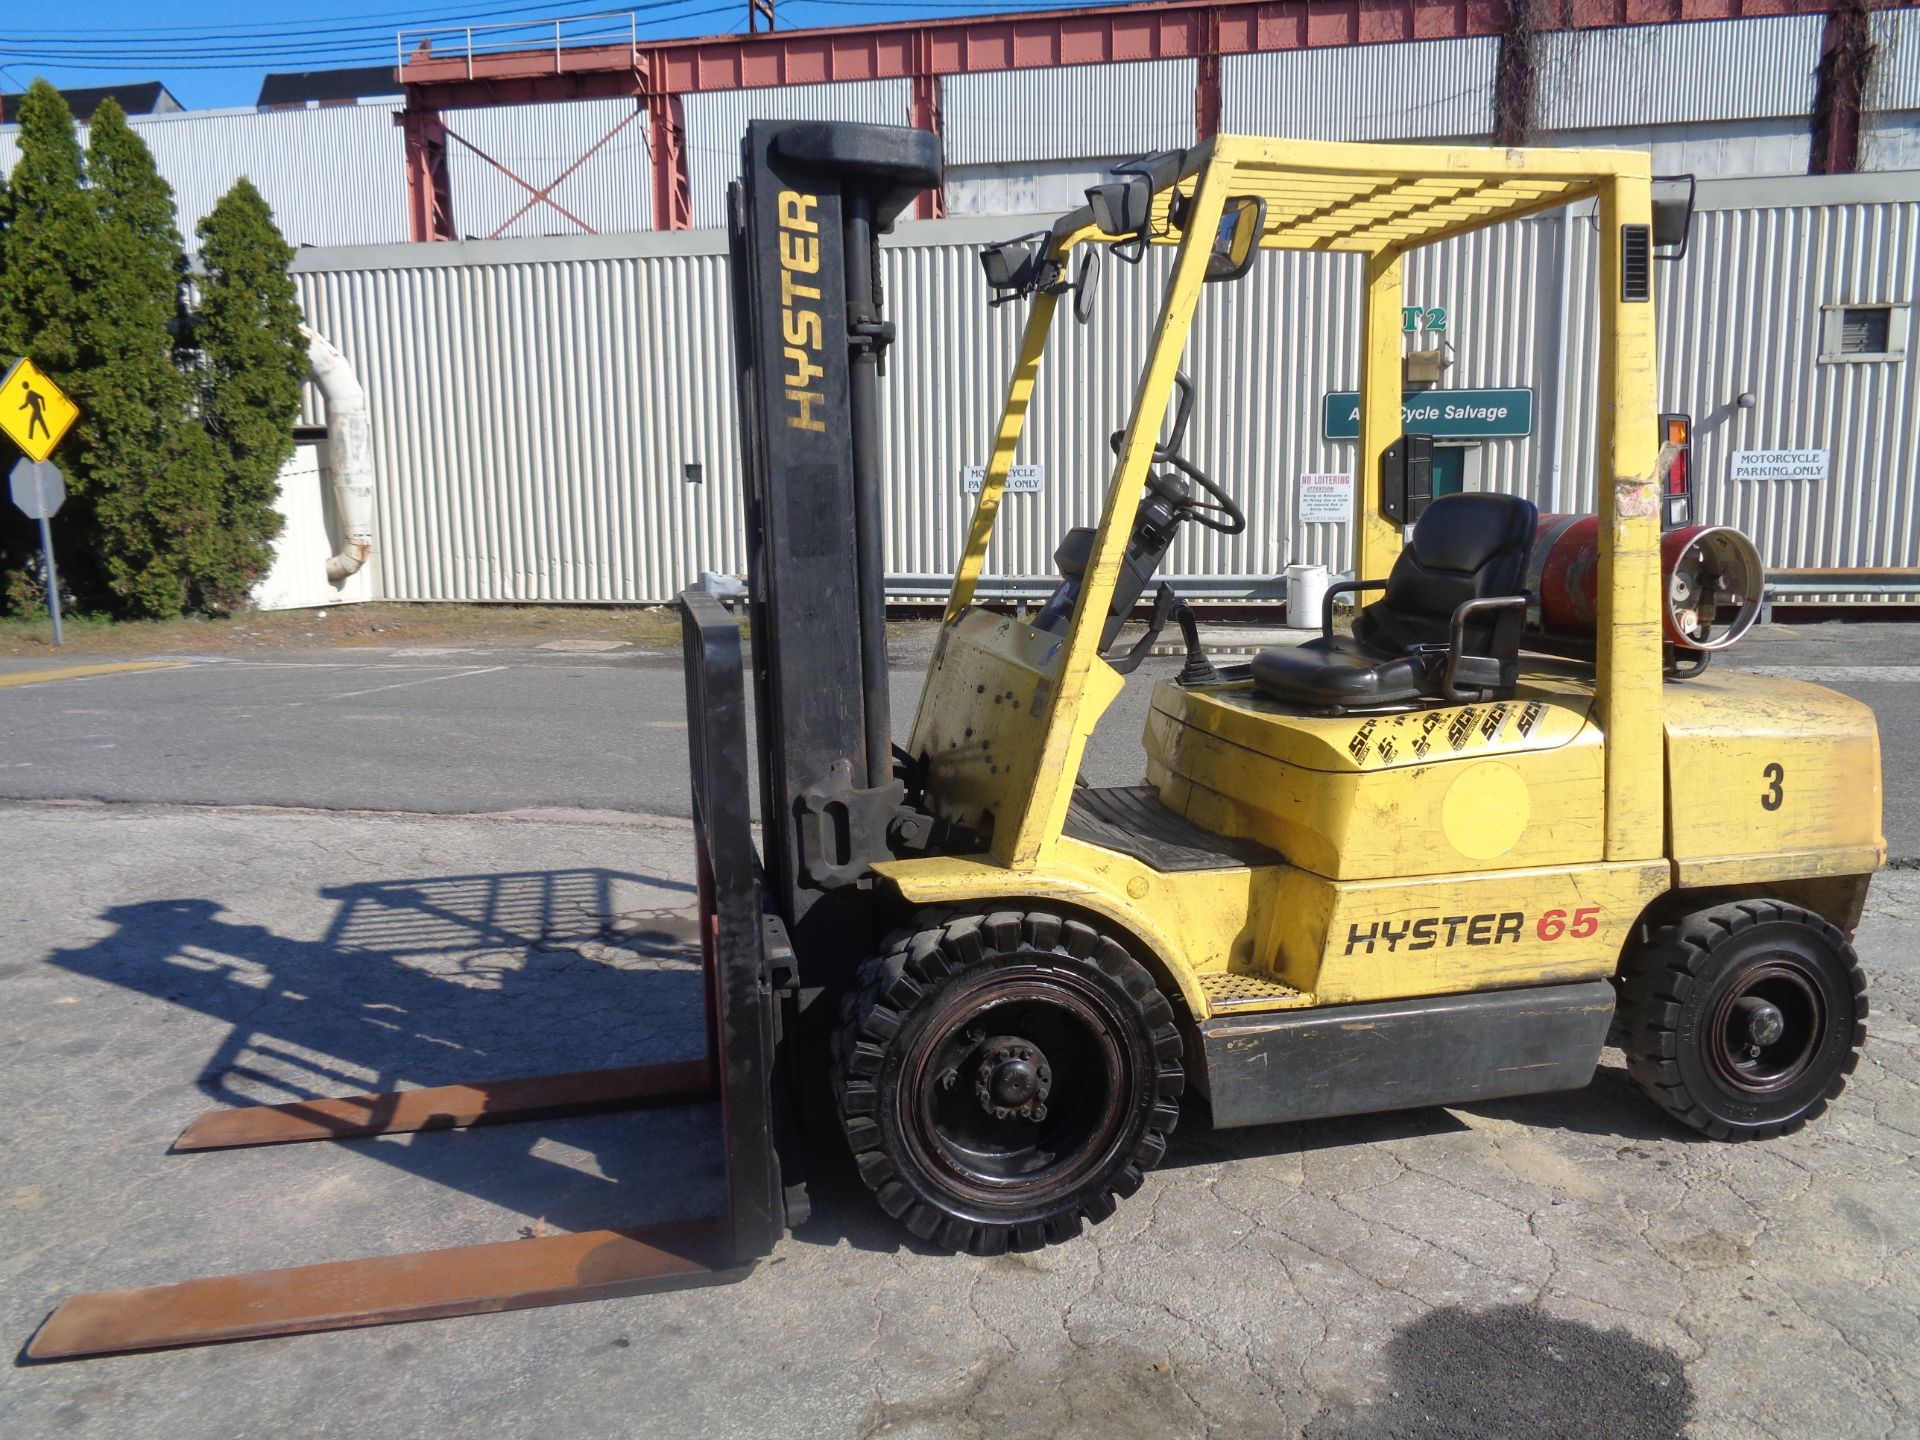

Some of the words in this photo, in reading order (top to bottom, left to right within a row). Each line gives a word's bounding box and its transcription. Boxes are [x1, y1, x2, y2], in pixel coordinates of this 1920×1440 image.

[778, 190, 826, 433] HYSTER
[1401, 406, 1439, 423] Cycle
[1444, 405, 1508, 422] Salvage
[1741, 454, 1820, 464] MOTORCYCLE
[971, 469, 1035, 478] MOCYCLE
[1736, 467, 1788, 476] PARKING
[1793, 466, 1823, 476] ONLY
[1014, 480, 1039, 488] ONLY
[1301, 475, 1312, 485] NO
[1314, 475, 1350, 485] LOITERING
[1448, 707, 1478, 748] SCP
[1760, 762, 1785, 812] 3
[1343, 911, 1525, 956] HYSTER
[1536, 906, 1601, 942] 65
